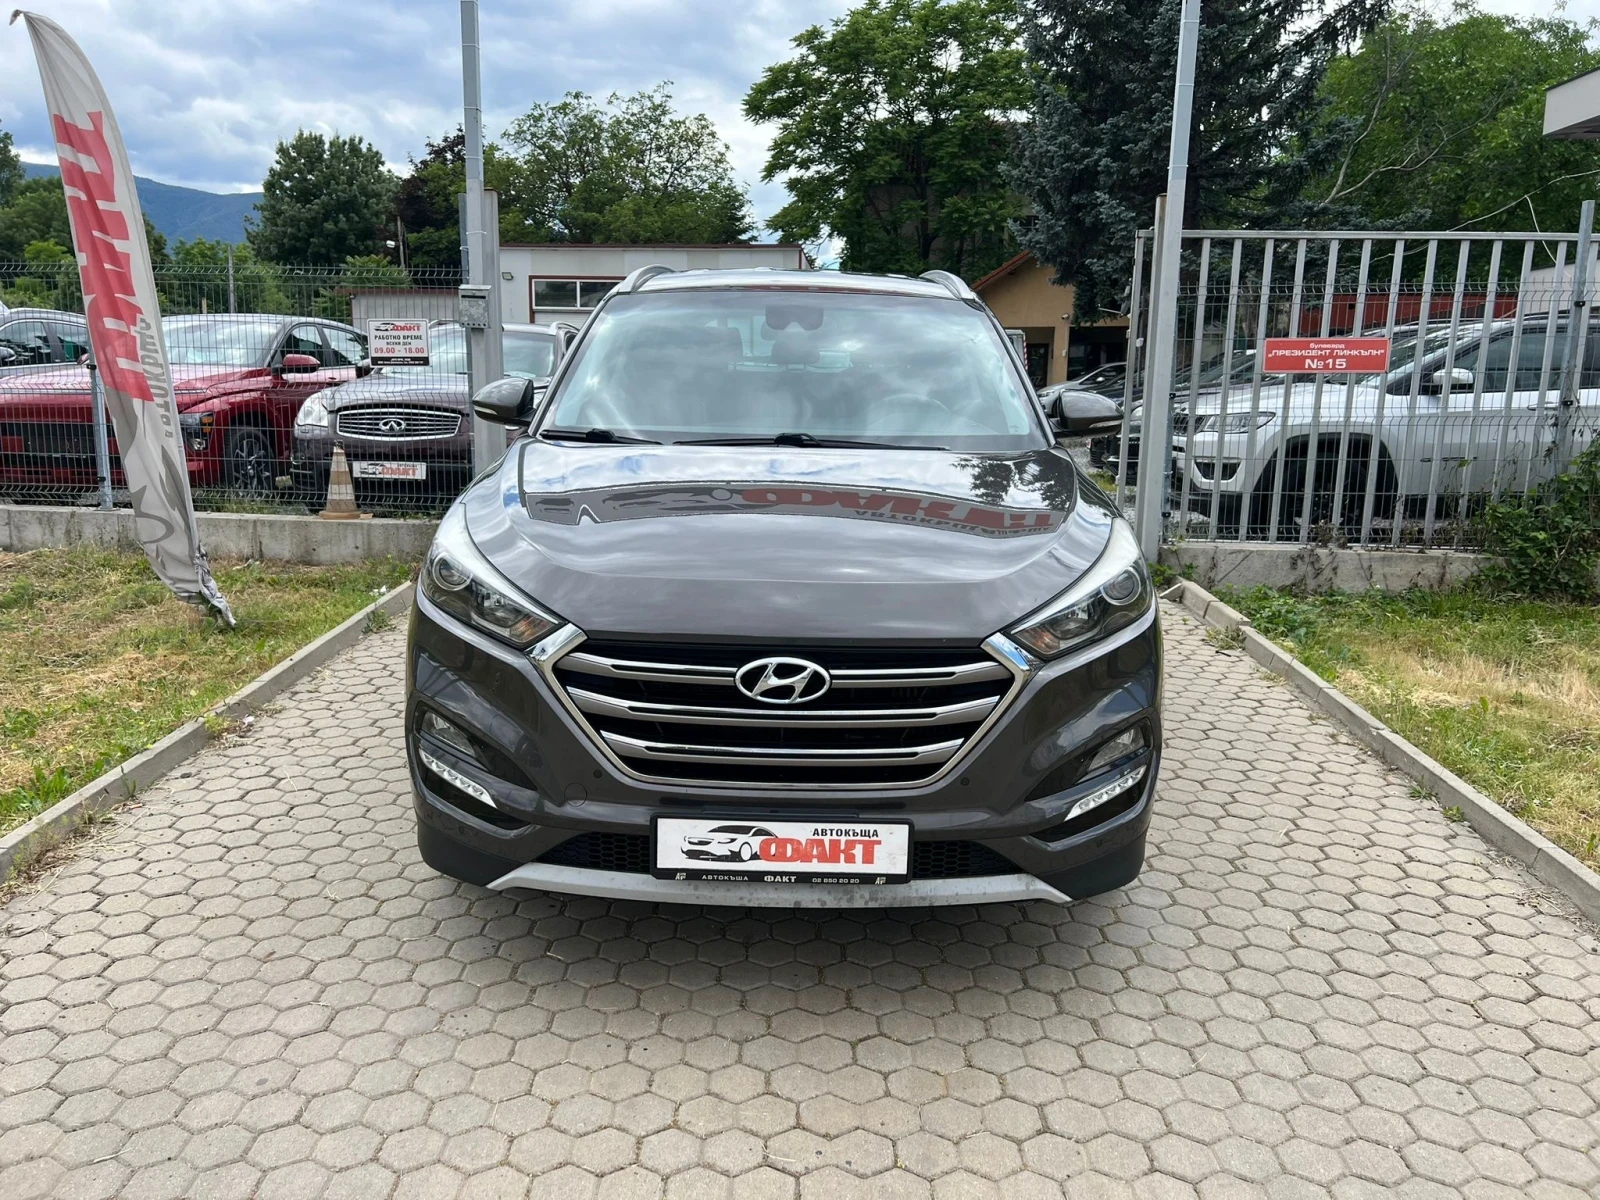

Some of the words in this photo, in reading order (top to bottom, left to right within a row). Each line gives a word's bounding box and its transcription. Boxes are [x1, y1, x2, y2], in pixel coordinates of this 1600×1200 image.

[812, 828, 879, 838] АВТОКЪЩА
[759, 837, 881, 864] ФАКТ
[763, 875, 797, 883] ФАКТ
